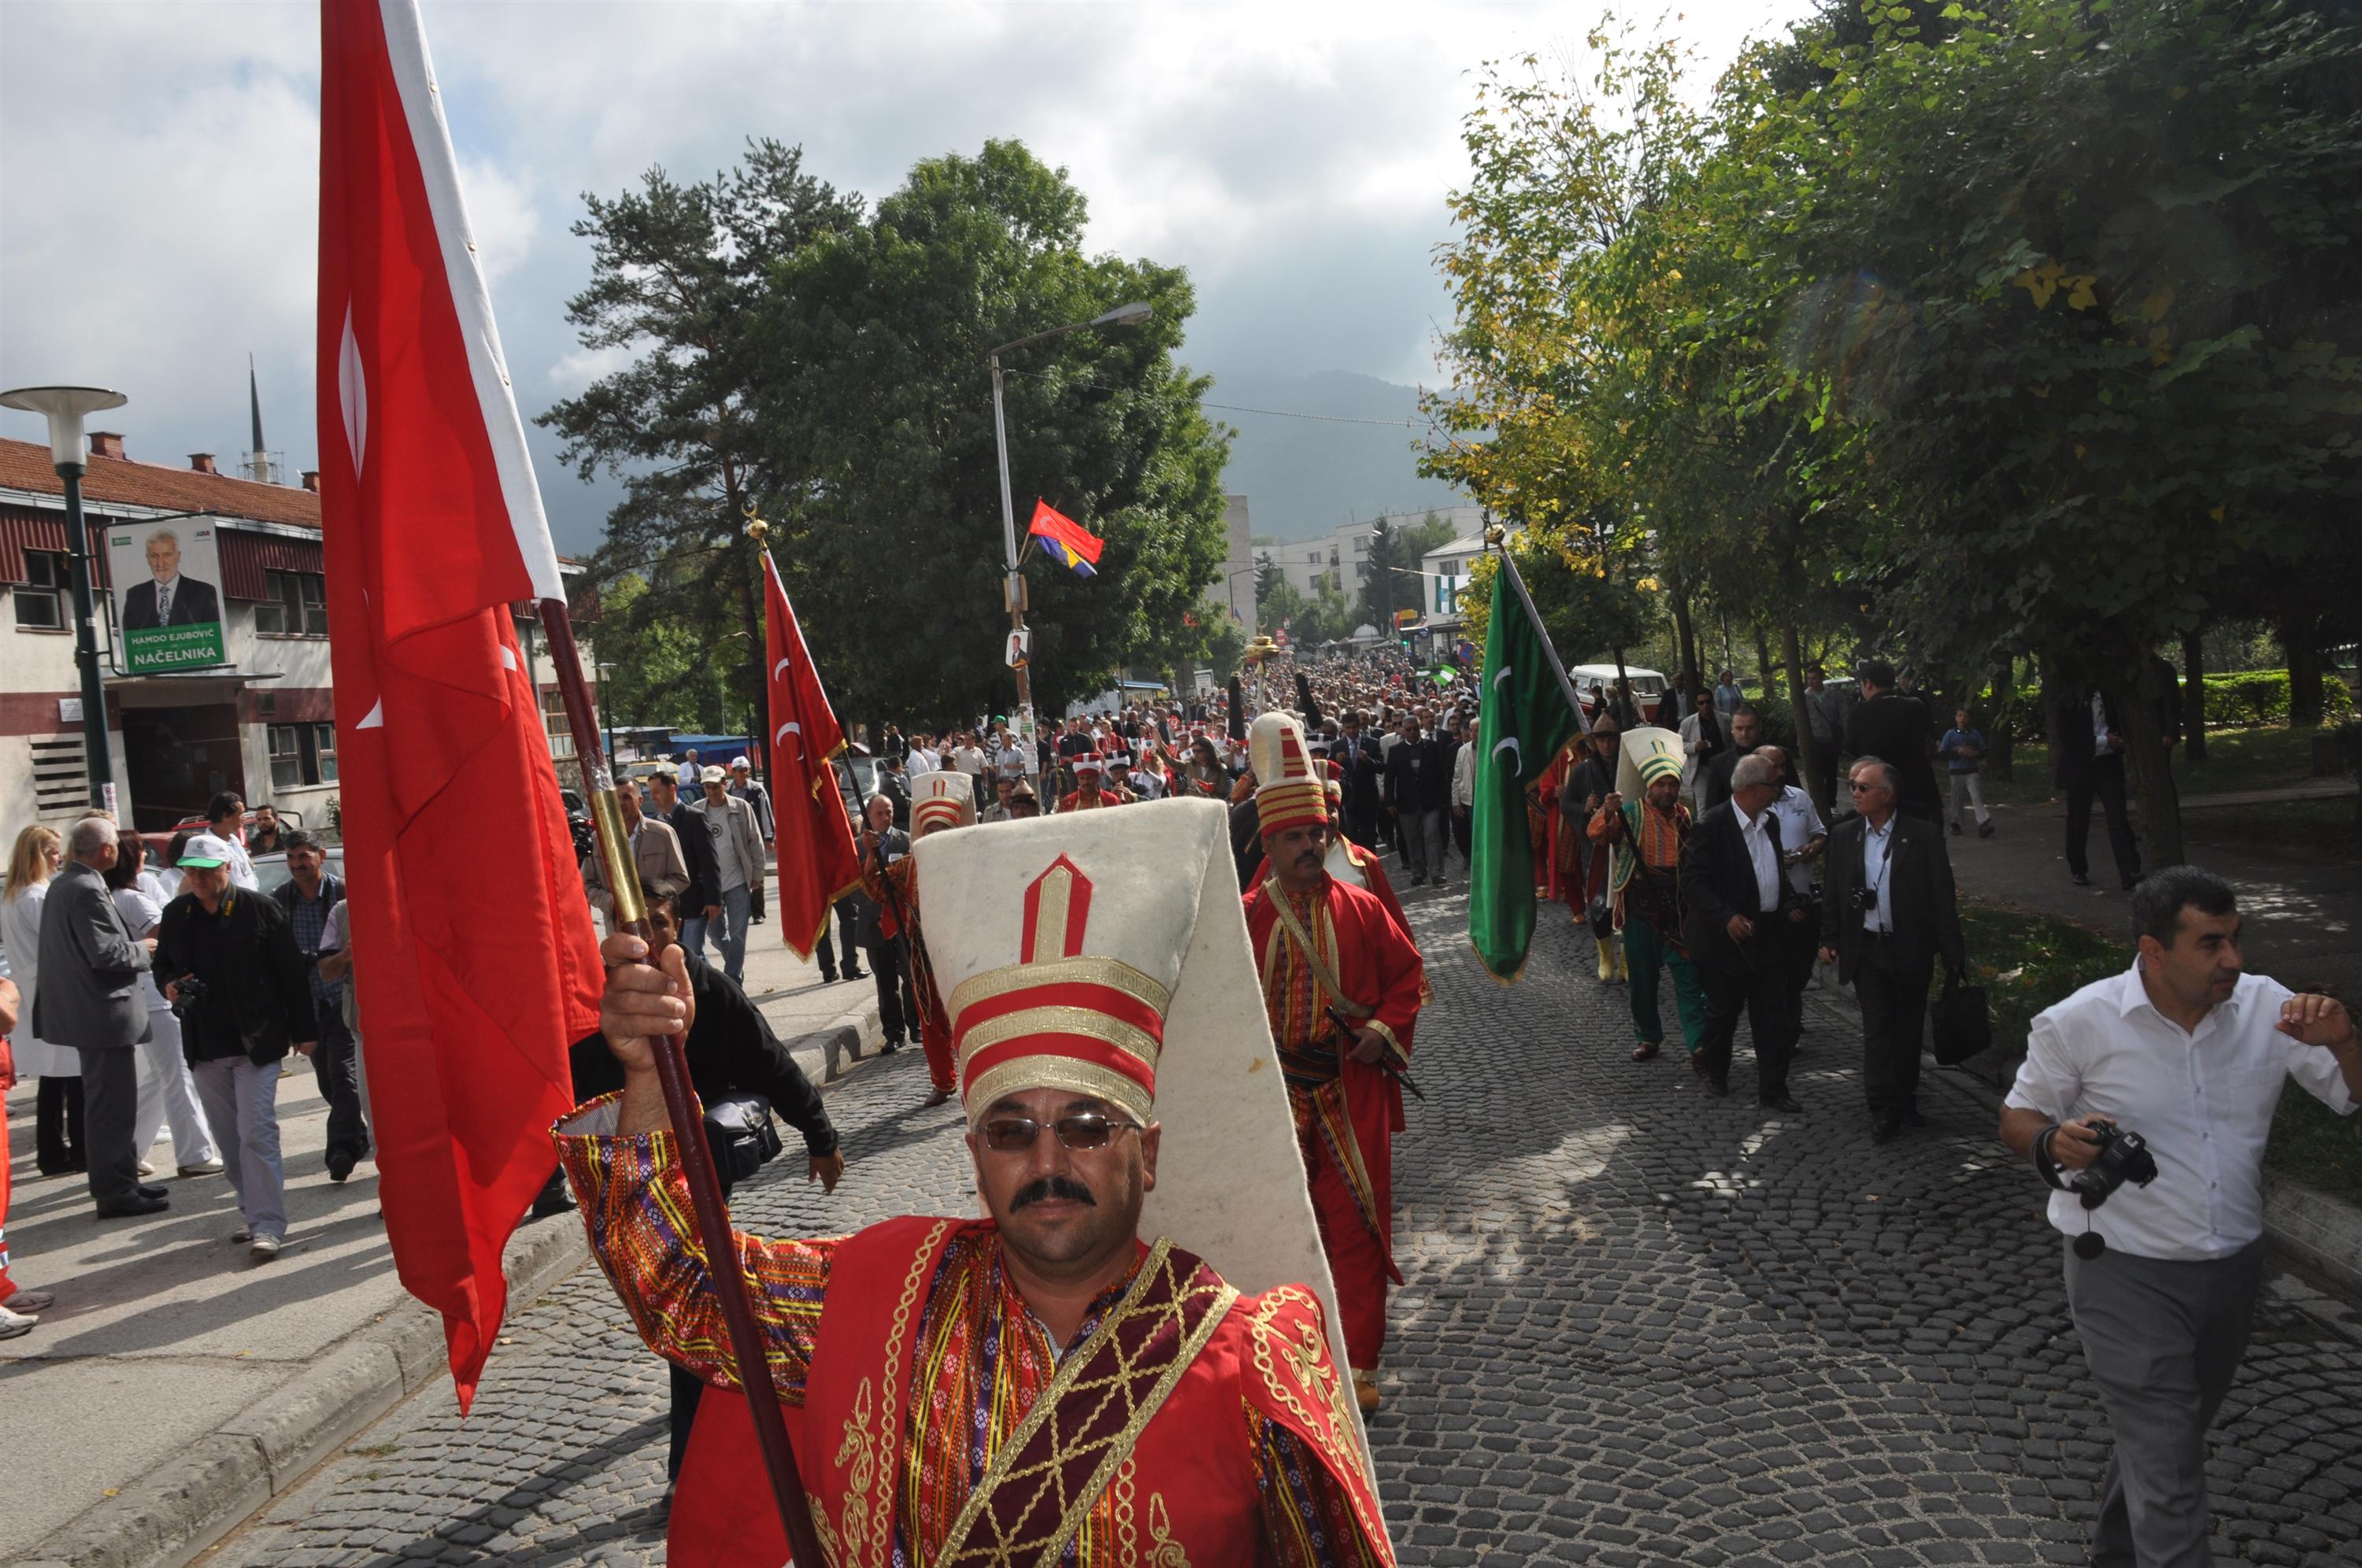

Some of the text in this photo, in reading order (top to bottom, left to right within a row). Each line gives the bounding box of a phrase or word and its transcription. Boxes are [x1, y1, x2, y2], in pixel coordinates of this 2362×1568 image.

[131, 628, 214, 645] HAMDO EJUBOVIĆ
[134, 647, 217, 665] NAČELNIKA
